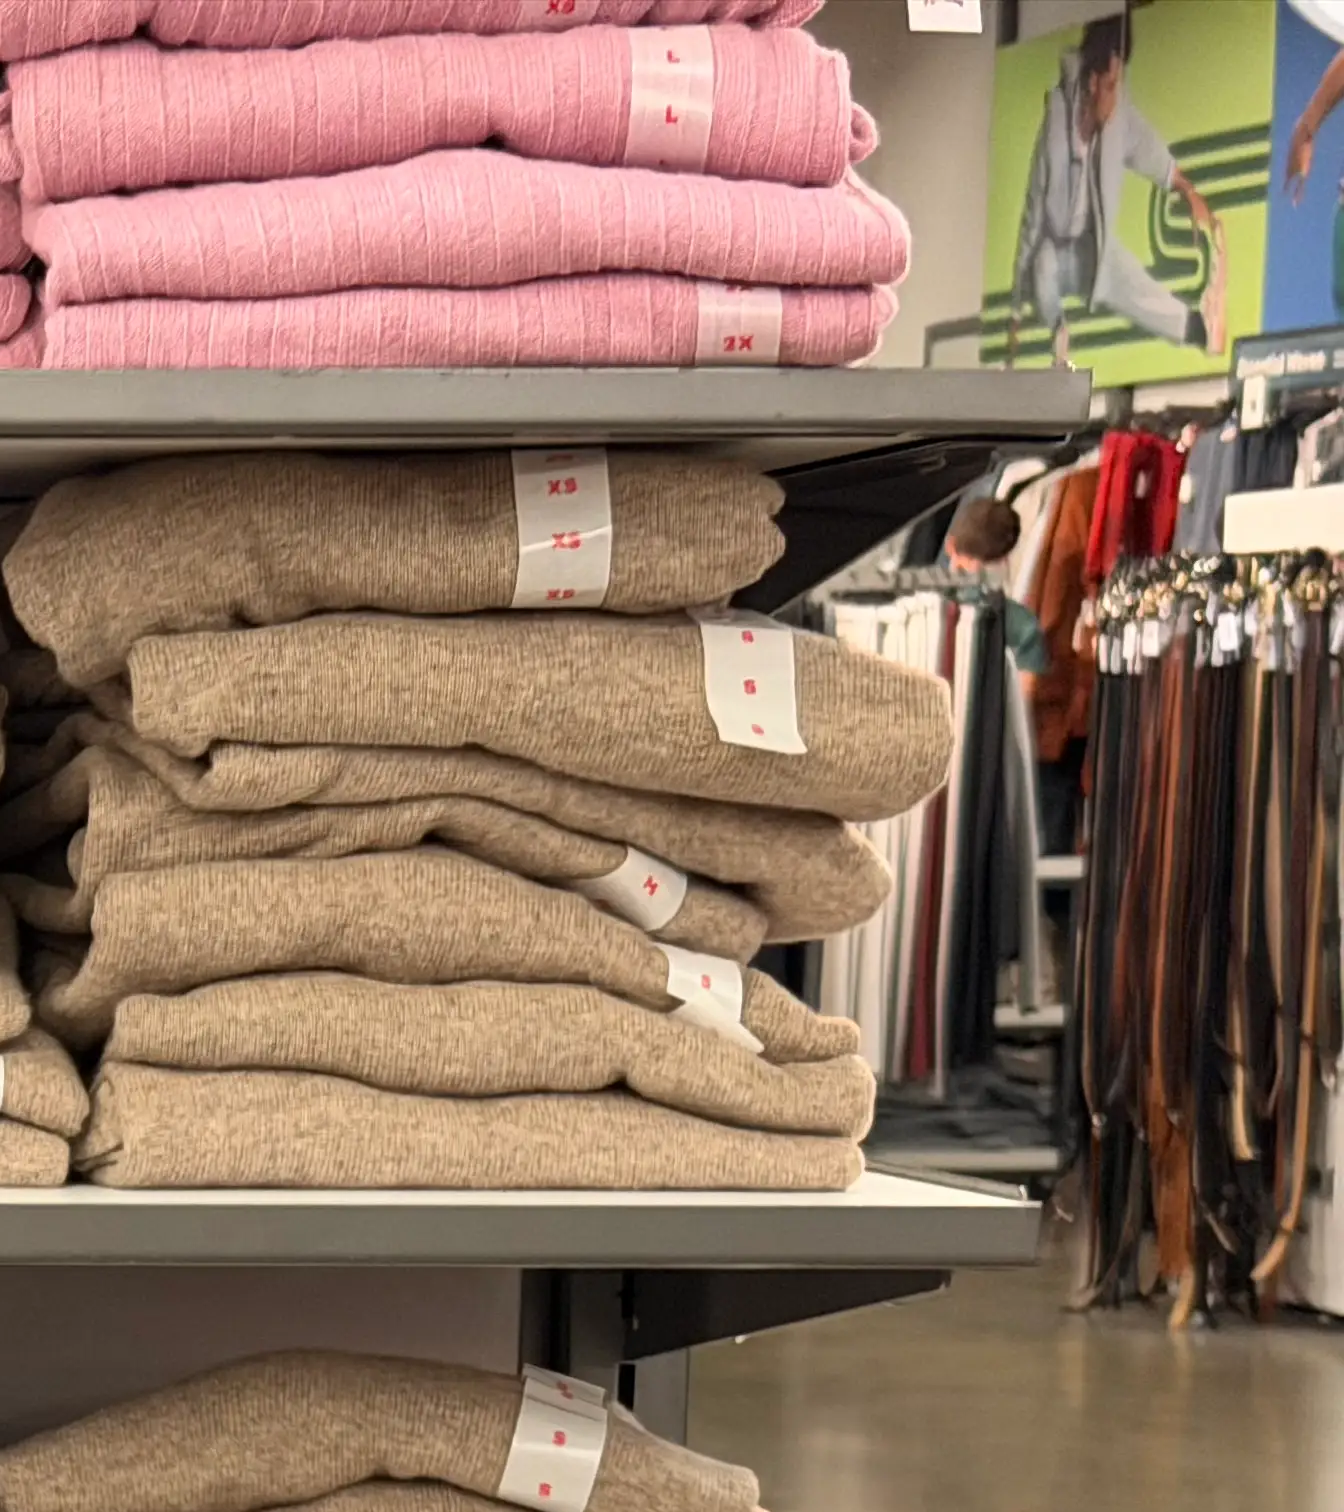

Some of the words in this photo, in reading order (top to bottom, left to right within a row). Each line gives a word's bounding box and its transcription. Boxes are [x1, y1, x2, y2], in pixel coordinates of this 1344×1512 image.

[666, 50, 680, 63] L
[665, 105, 677, 124] L
[724, 335, 753, 352] 2X
[548, 477, 578, 496] XS
[552, 530, 582, 551] XS
